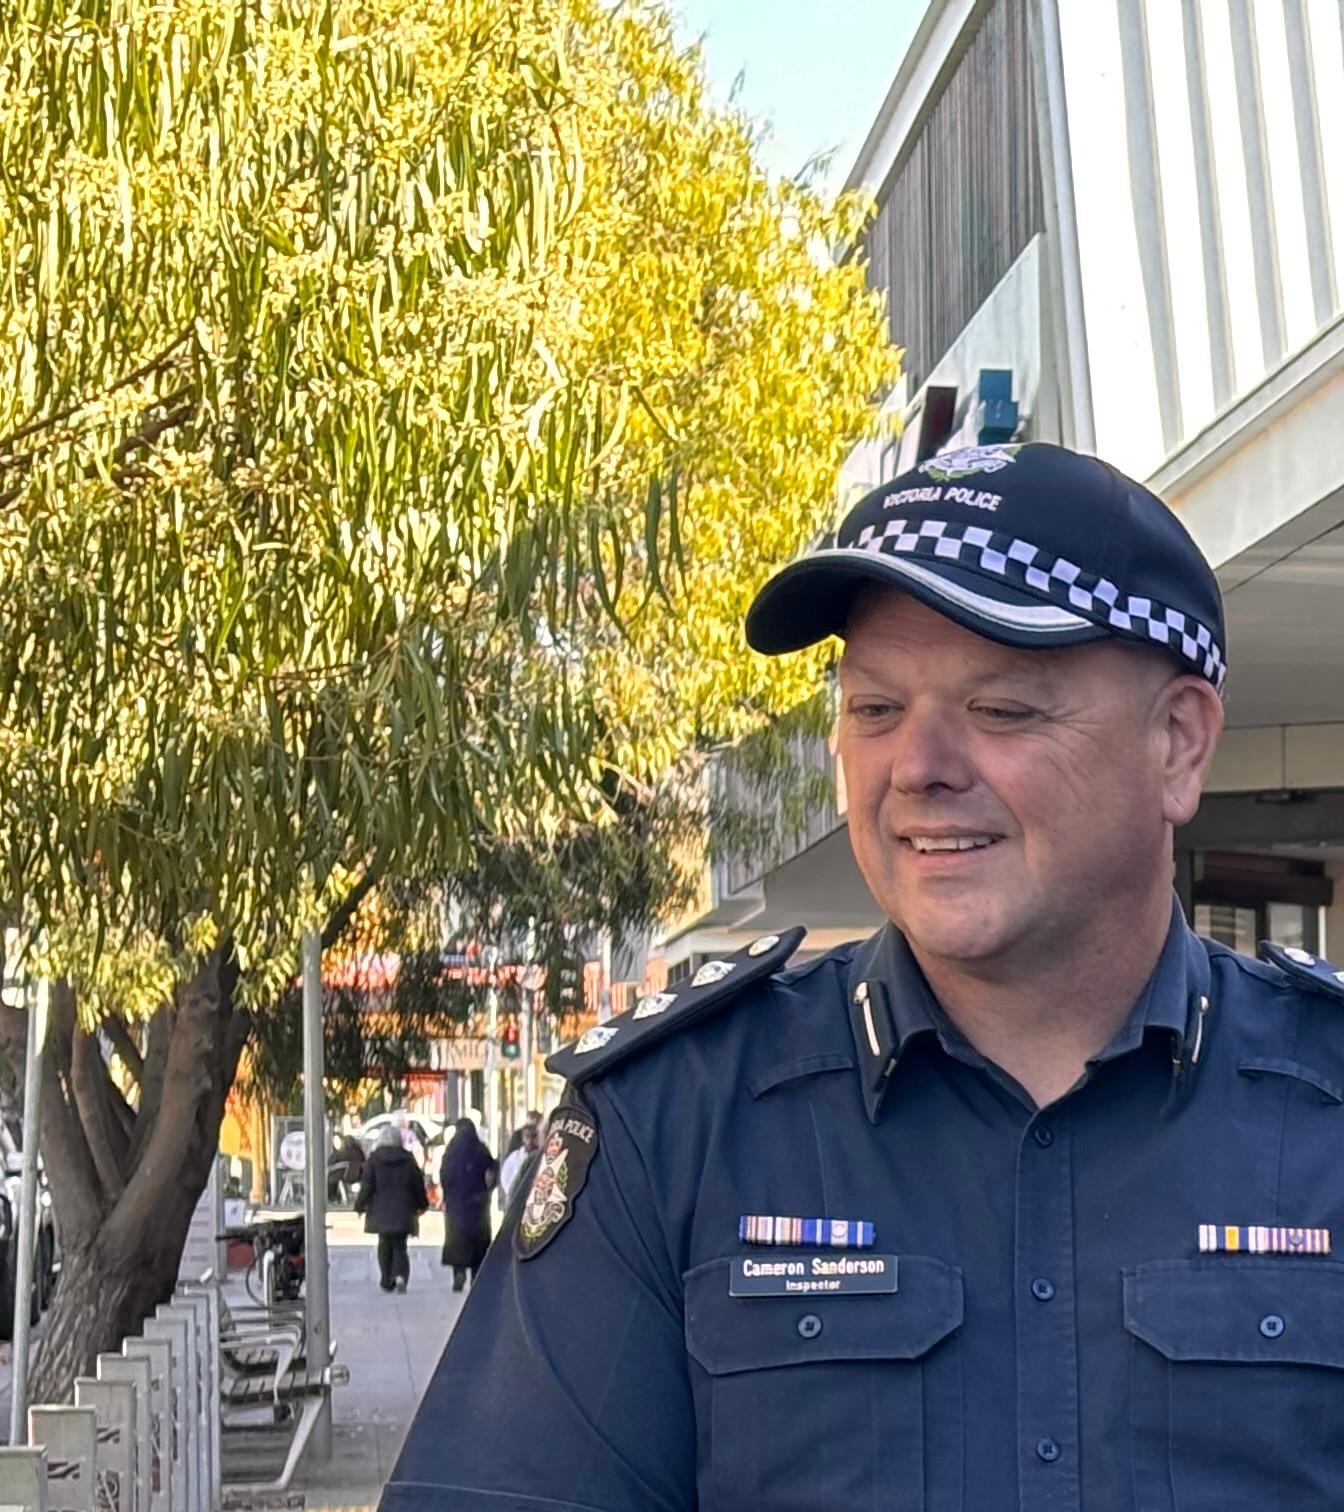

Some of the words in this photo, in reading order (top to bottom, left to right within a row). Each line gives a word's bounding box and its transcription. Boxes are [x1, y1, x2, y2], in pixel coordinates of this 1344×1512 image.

[883, 486, 942, 509] VICTORIA
[944, 487, 1002, 511] POLICE
[565, 1118, 595, 1144] POLICE
[743, 1259, 805, 1277] Cameron
[811, 1257, 885, 1275] Sanderson
[785, 1279, 841, 1292] Inspector
